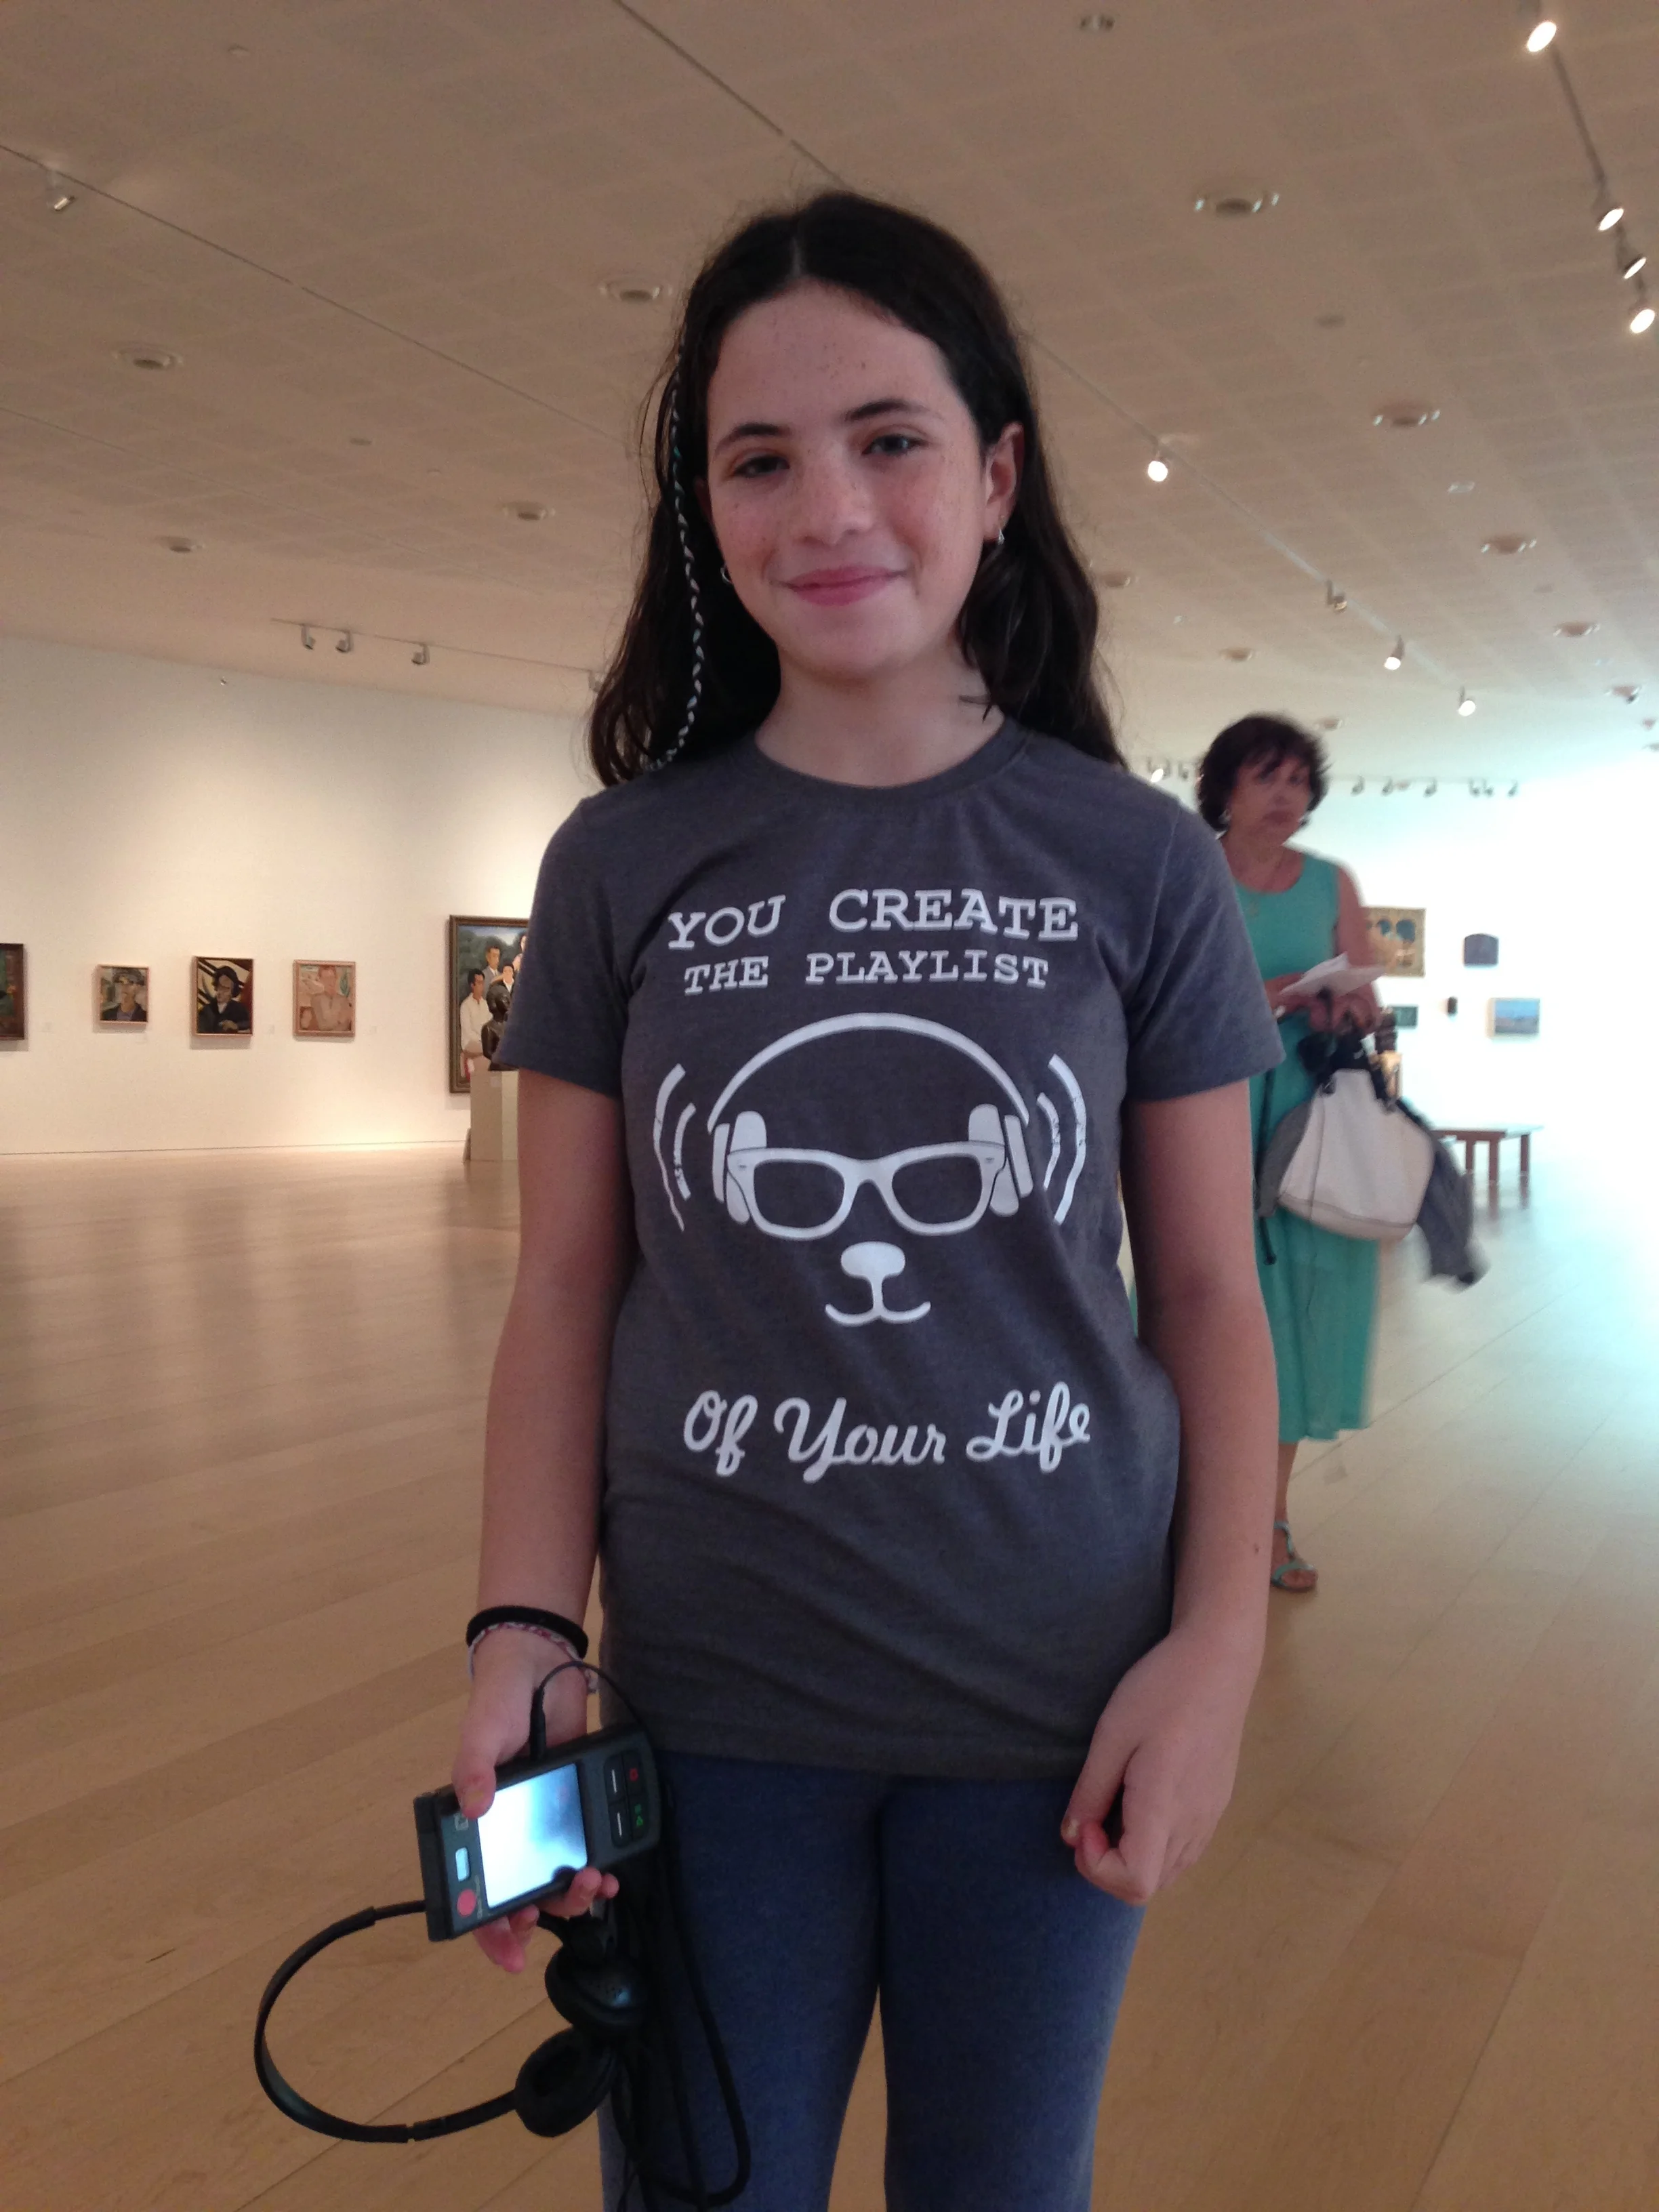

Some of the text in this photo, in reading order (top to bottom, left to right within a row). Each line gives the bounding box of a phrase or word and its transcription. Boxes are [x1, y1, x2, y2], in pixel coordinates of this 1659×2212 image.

[668, 888, 1079, 949] YOU CREATE
[684, 949, 1049, 996] THE PLAYLIST
[683, 1380, 1091, 1484] Of Your Life
